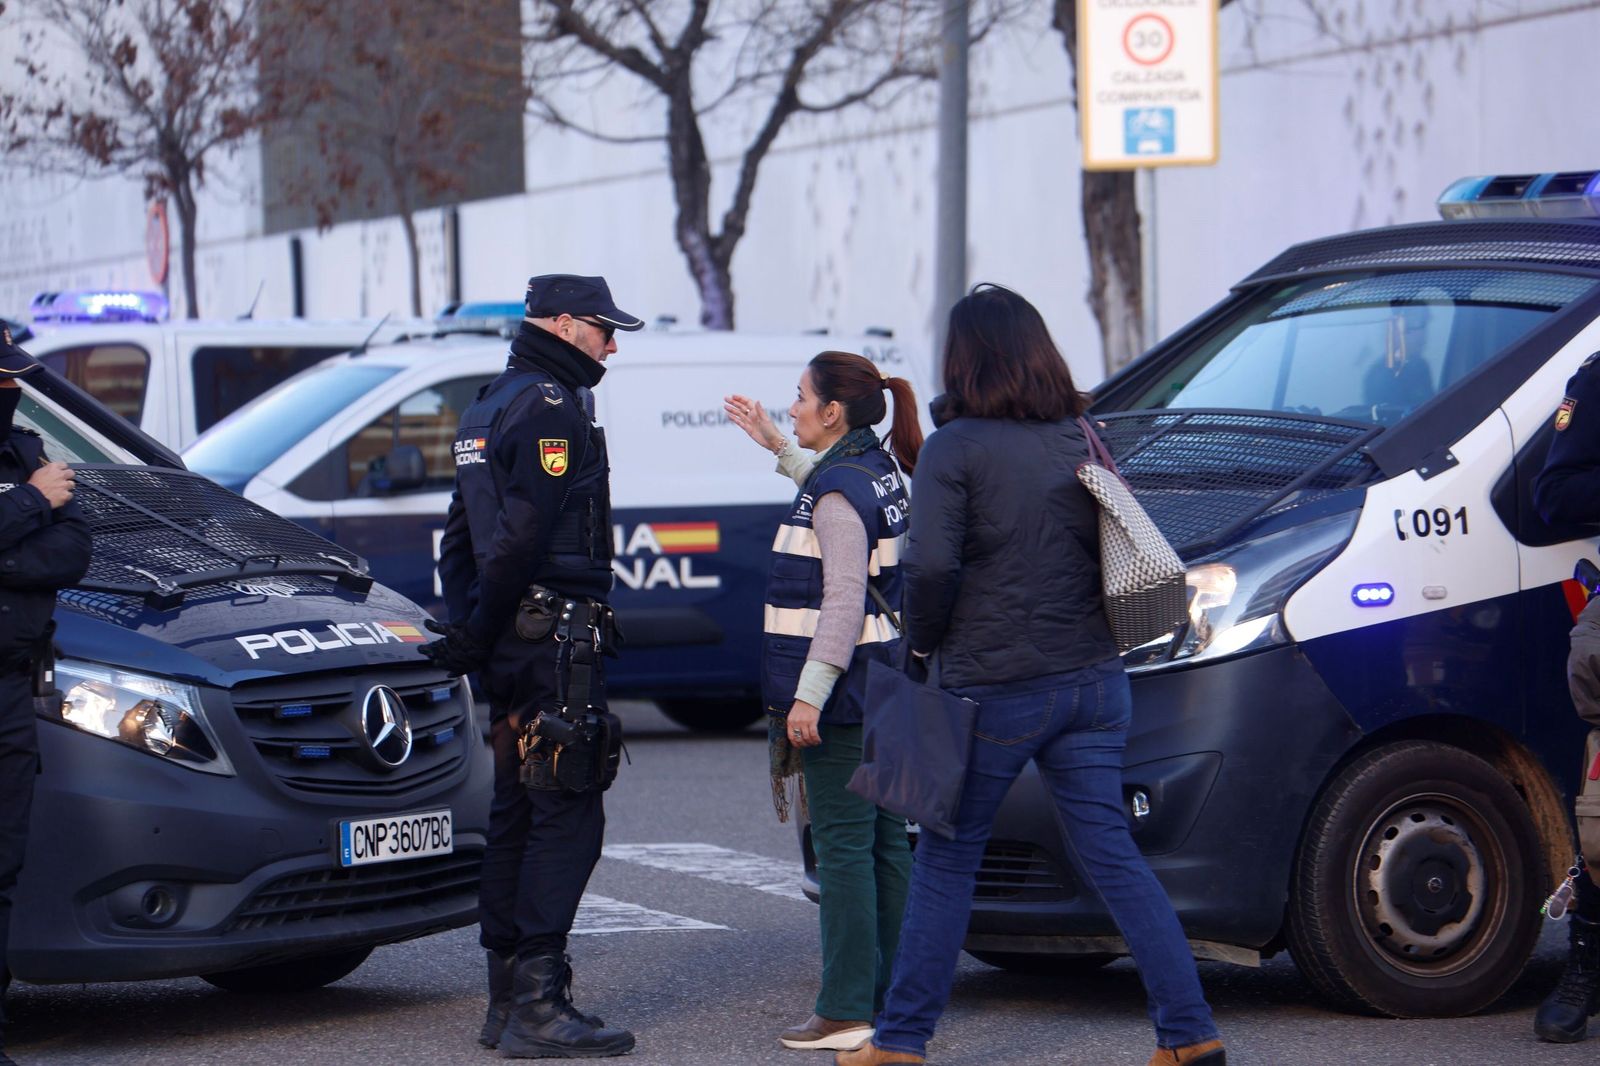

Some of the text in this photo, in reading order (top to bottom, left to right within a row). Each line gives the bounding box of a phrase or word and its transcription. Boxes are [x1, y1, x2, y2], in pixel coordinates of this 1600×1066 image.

[1134, 30, 1163, 48] 30
[1412, 506, 1468, 537] 091
[353, 815, 451, 858] CNP3607BC
